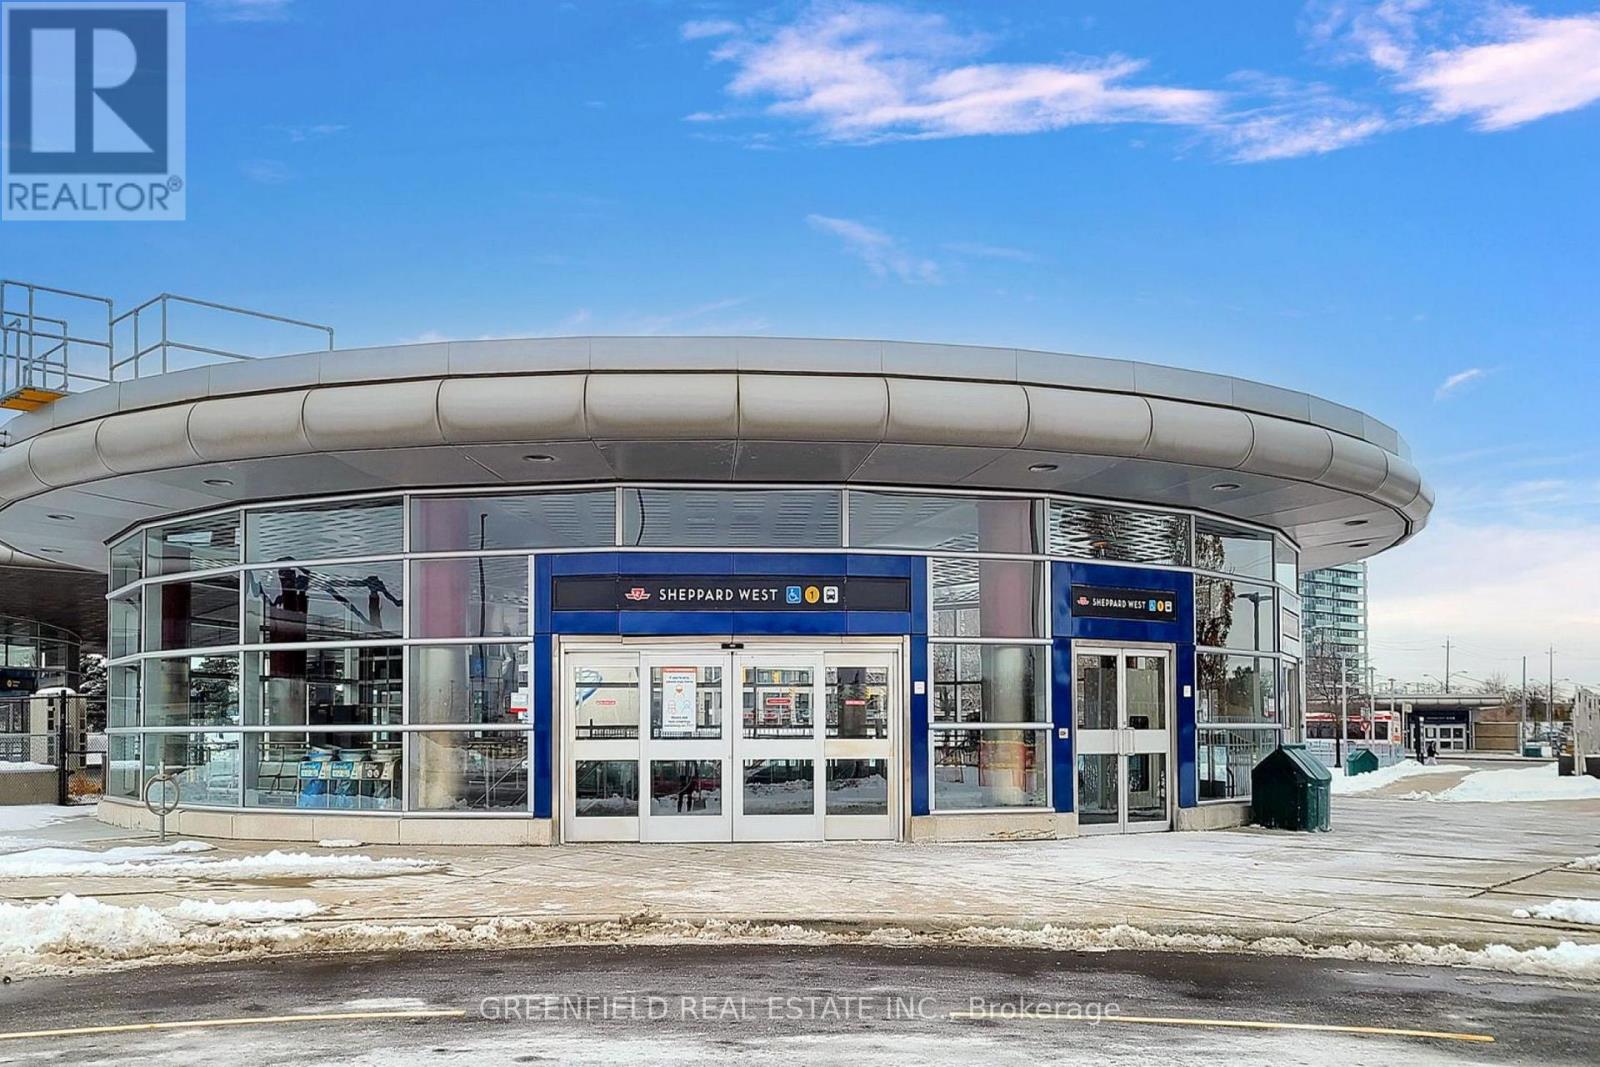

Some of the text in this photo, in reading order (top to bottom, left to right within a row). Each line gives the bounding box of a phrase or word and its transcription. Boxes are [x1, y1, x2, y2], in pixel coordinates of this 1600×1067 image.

[659, 588, 734, 601] SHEPPARD
[739, 588, 778, 601] WEST
[1092, 597, 1127, 609] SHEPPARD
[1127, 600, 1146, 609] WEST
